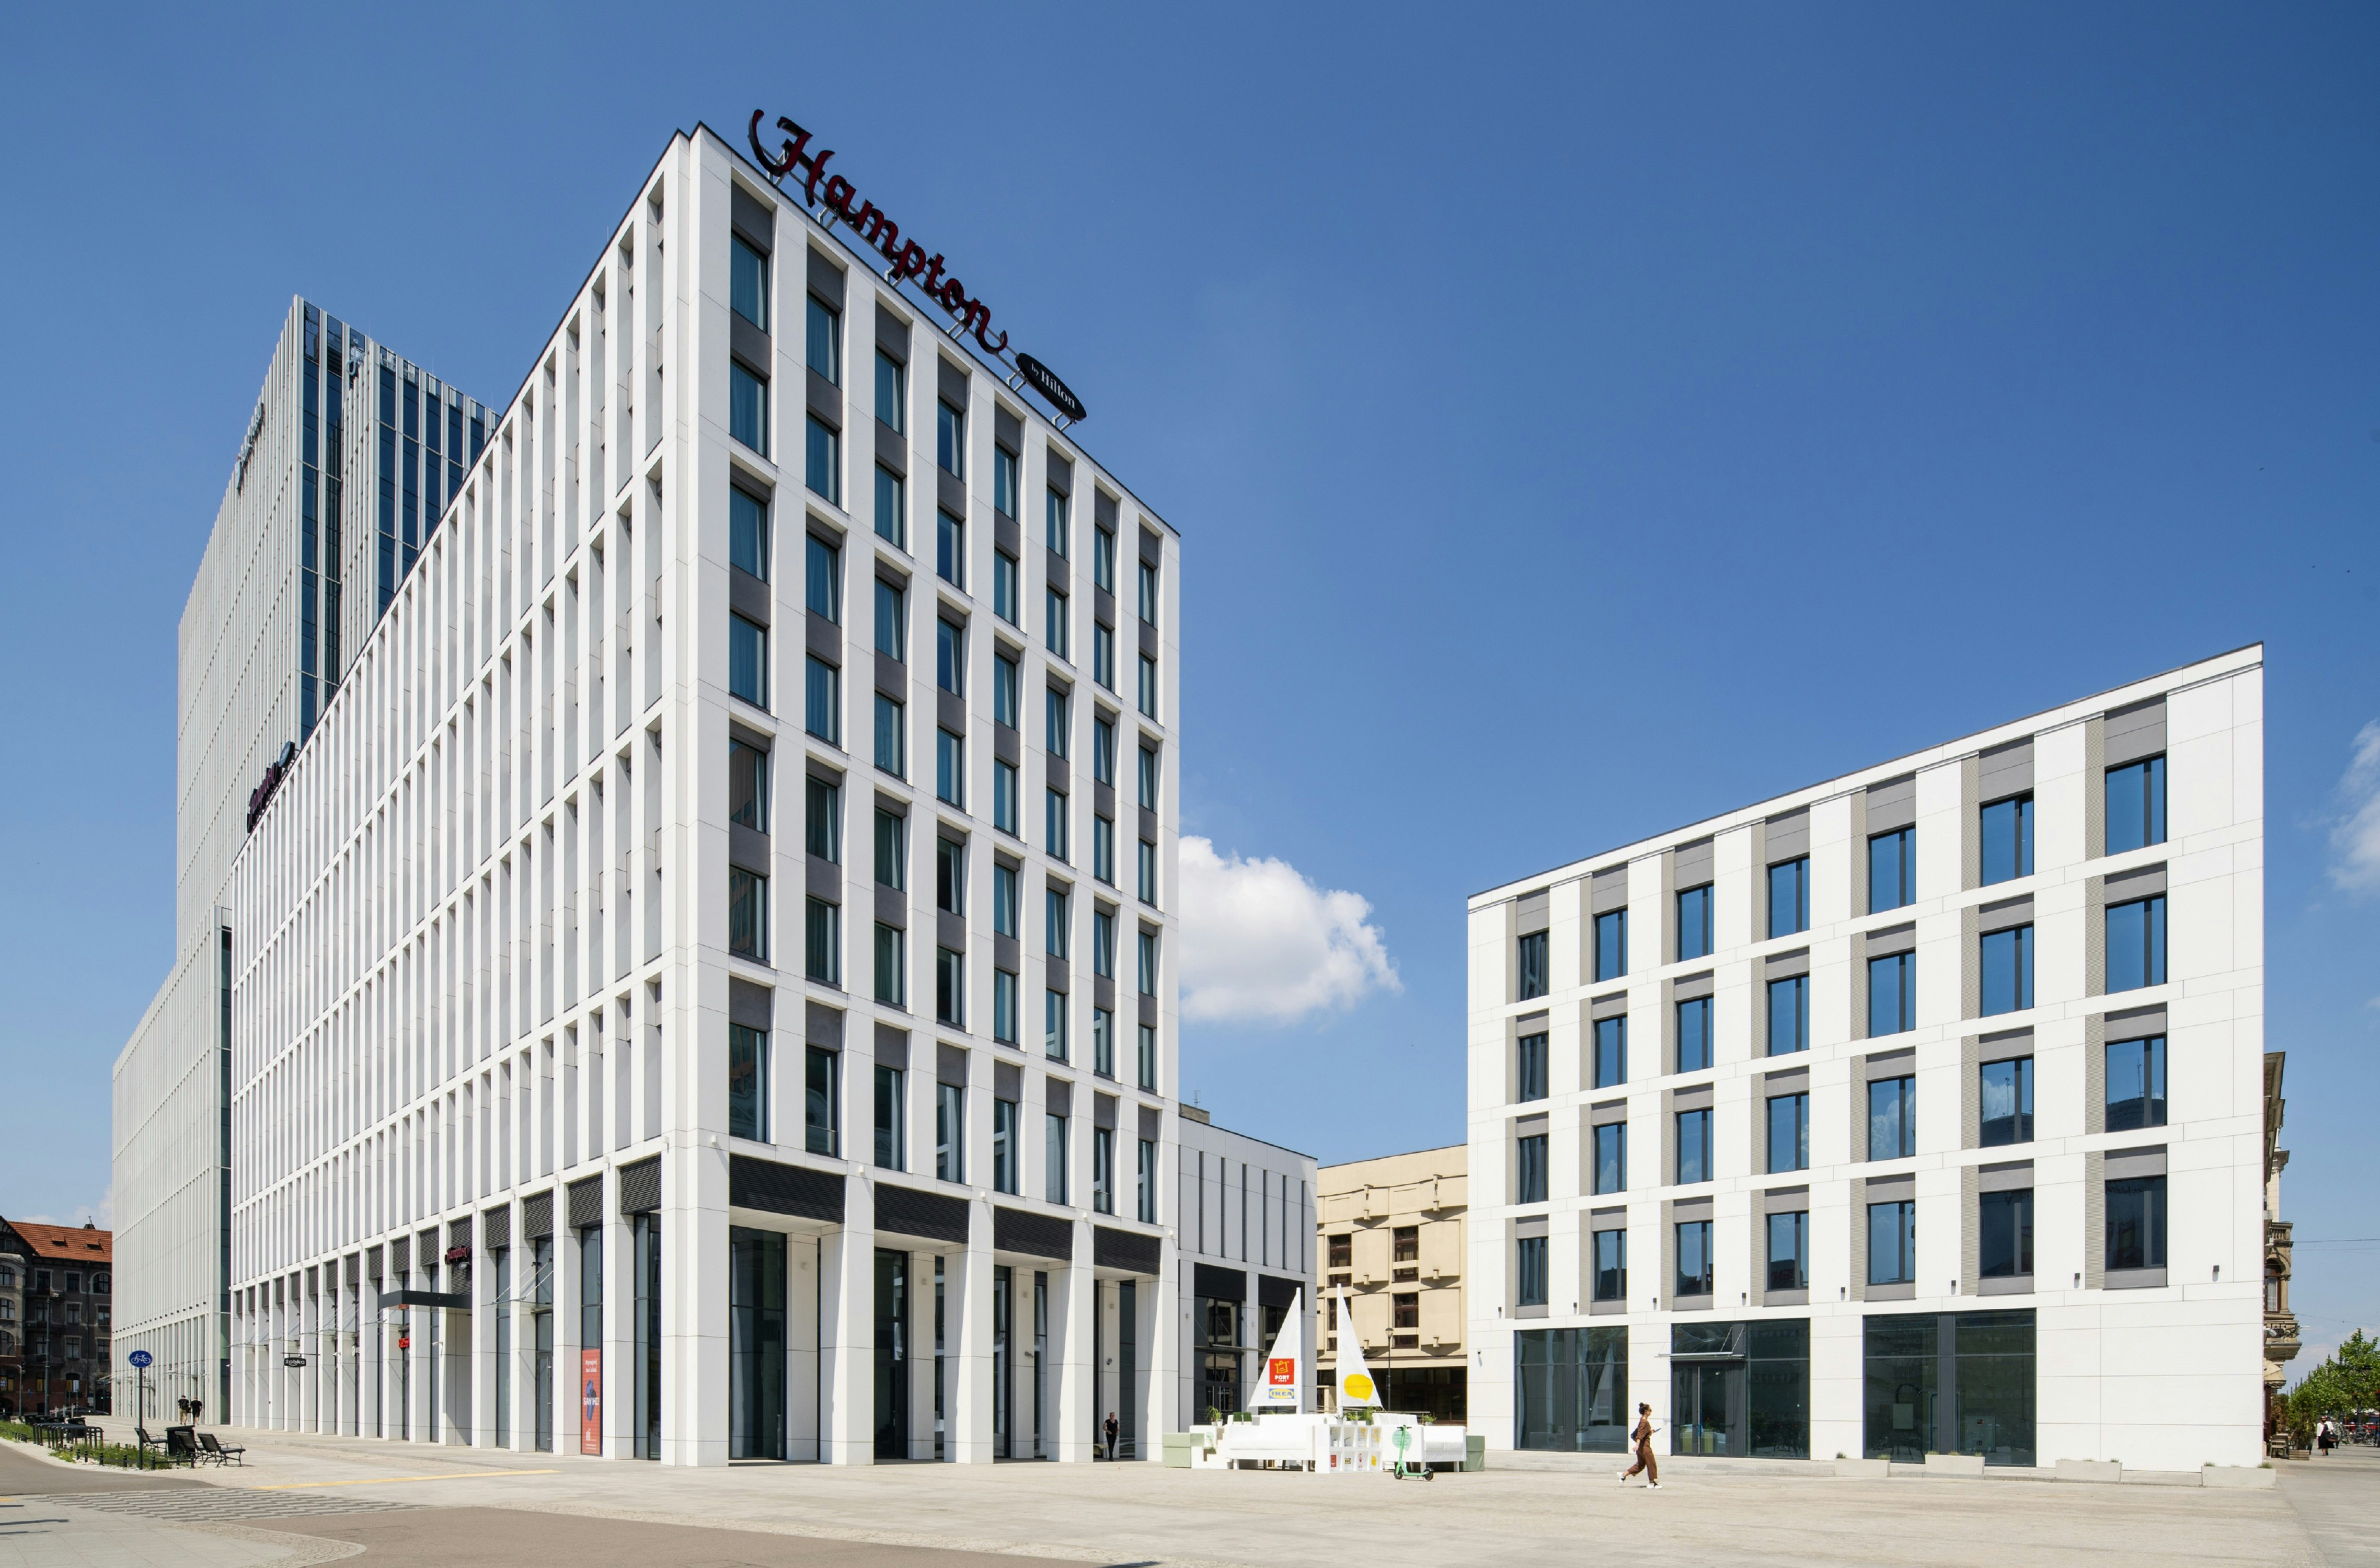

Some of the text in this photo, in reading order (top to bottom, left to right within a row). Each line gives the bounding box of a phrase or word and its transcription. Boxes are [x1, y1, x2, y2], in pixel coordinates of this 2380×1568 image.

[748, 109, 1008, 354] Hampton
[1031, 363, 1075, 410] by Hilton
